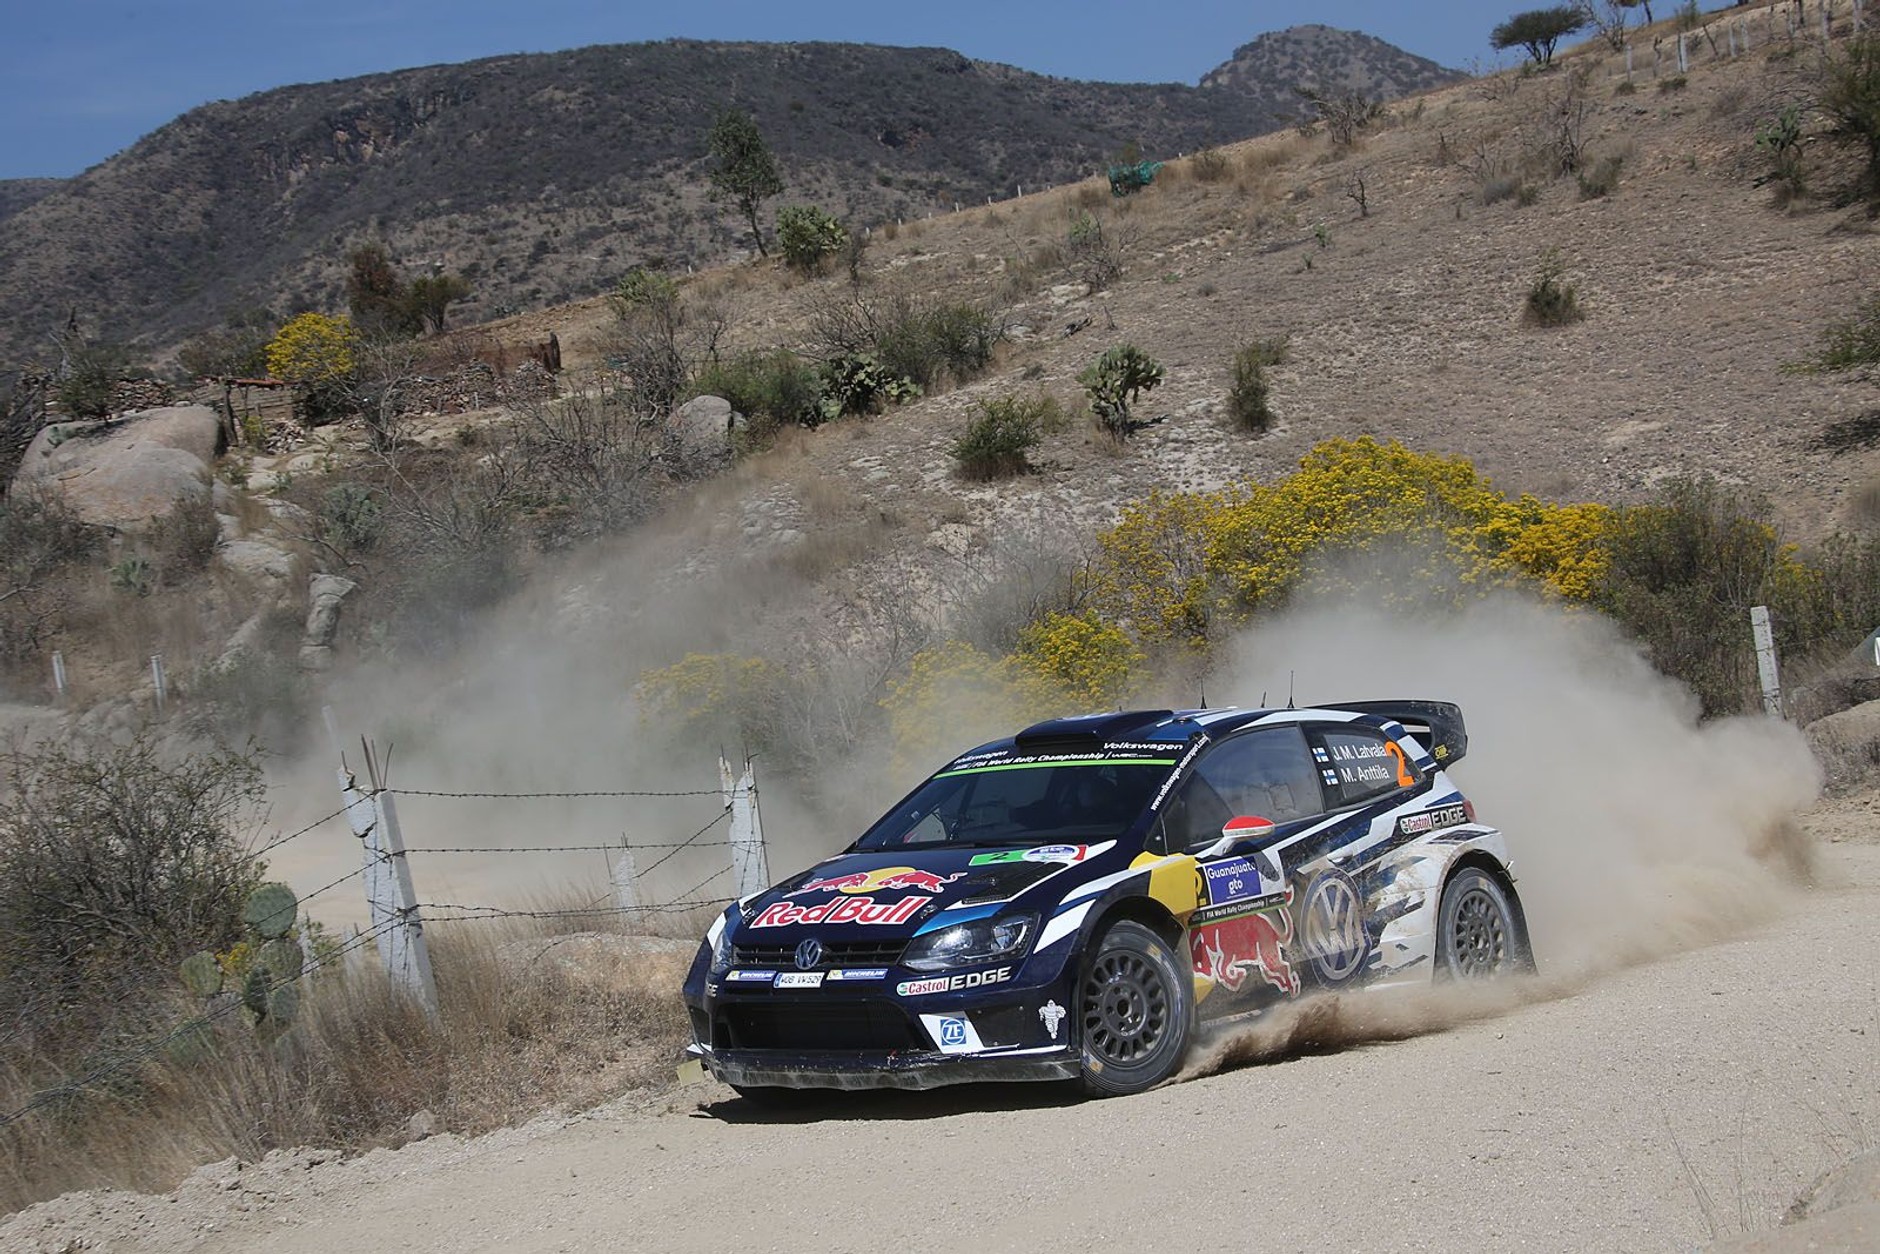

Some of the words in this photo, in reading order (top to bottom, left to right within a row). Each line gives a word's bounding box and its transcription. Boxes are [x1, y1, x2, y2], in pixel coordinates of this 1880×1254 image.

[1103, 742, 1184, 751] Volkswagen
[1352, 743, 1387, 759] Latvala
[988, 758, 1013, 766] World
[1013, 755, 1037, 764] Rally
[1037, 751, 1105, 761] Championship
[1384, 741, 1415, 787] 2
[1341, 767, 1357, 783] M.
[1357, 764, 1390, 781] Anttila
[1431, 806, 1468, 829] EDGE
[1207, 861, 1257, 879] Guanajuato
[1228, 878, 1244, 895] gto
[749, 896, 844, 929] Red
[824, 896, 934, 925] Bull
[844, 969, 886, 978] MICHELIN
[908, 979, 947, 994] Castrol
[949, 966, 1012, 991] EDGE
[943, 1023, 963, 1041] ZF
